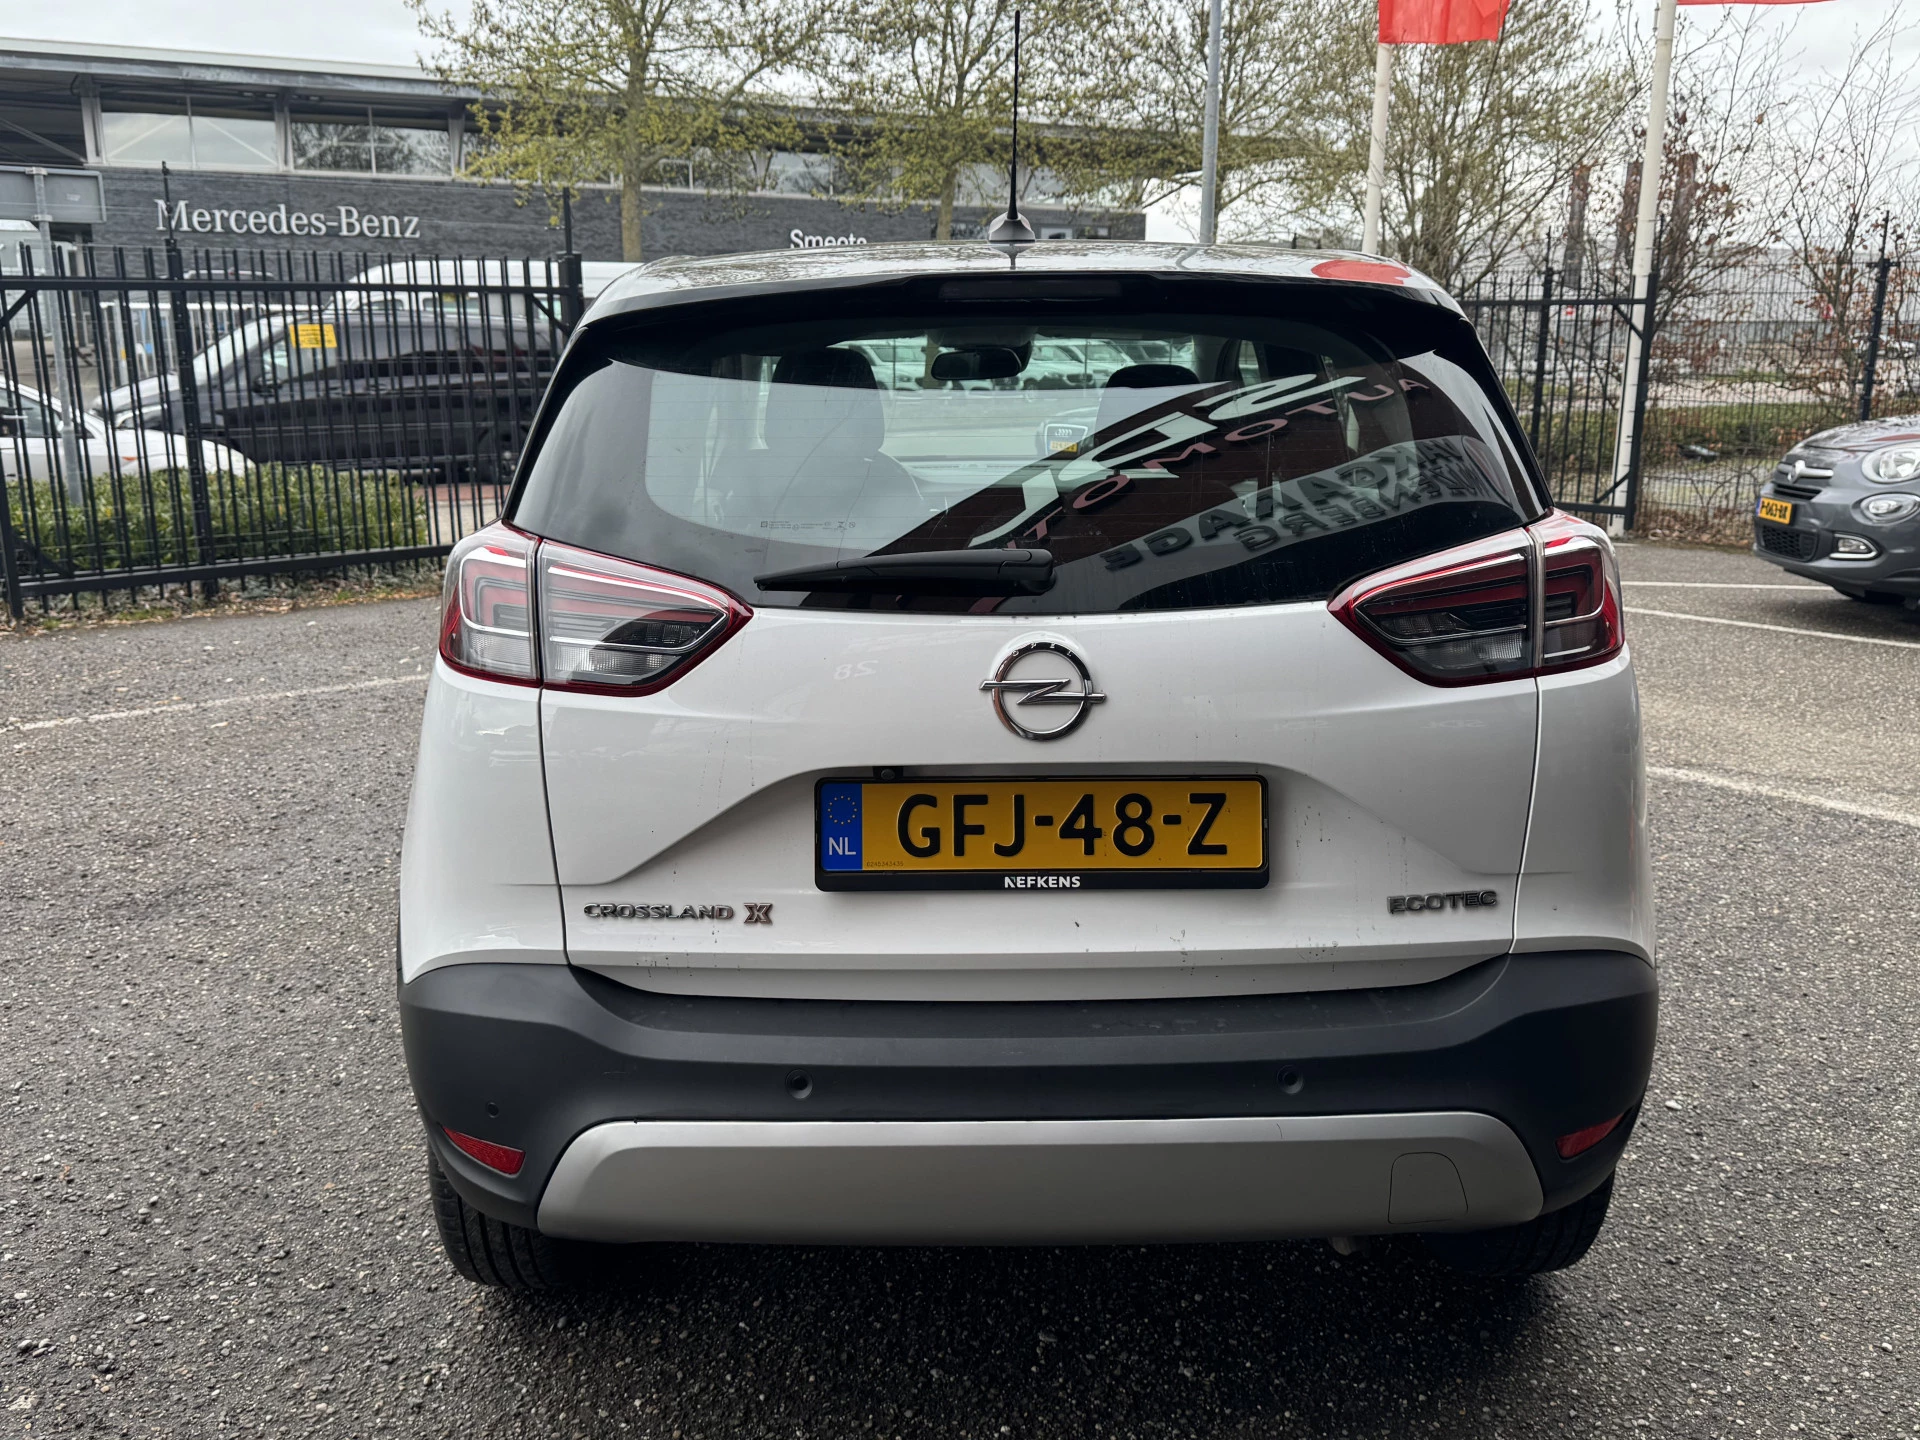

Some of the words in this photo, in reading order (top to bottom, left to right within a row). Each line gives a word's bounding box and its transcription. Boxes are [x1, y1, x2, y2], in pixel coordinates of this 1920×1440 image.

[153, 199, 421, 239] Mercedes-Benz
[897, 793, 1228, 858] GFJ-48-Z
[828, 837, 857, 857] NL
[1004, 875, 1081, 889] NEFKENS
[1387, 890, 1497, 913] ECOTEC
[583, 903, 734, 920] CROSSLAND
[743, 902, 773, 925] X
